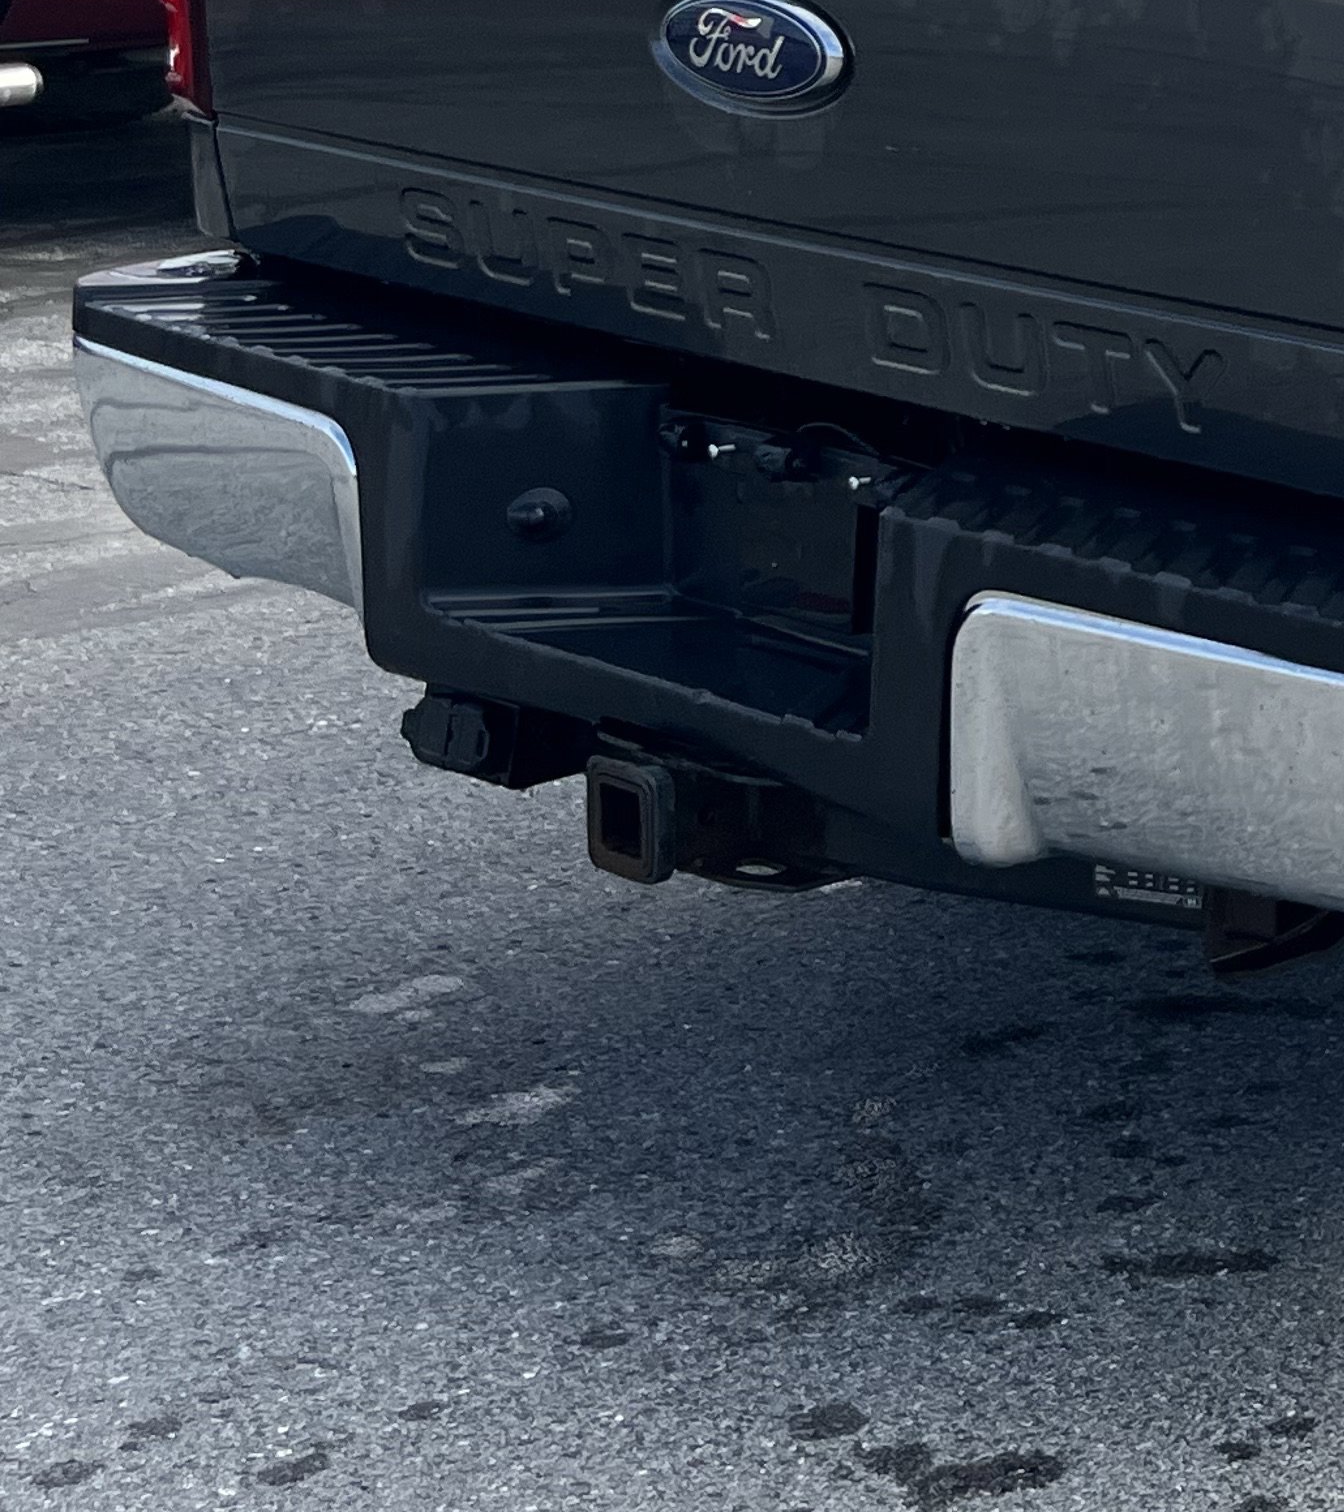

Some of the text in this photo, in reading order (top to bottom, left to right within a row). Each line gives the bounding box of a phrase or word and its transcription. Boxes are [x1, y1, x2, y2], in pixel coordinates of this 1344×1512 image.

[689, 7, 785, 80] Ford
[402, 187, 1228, 436] SUPER DUTY
